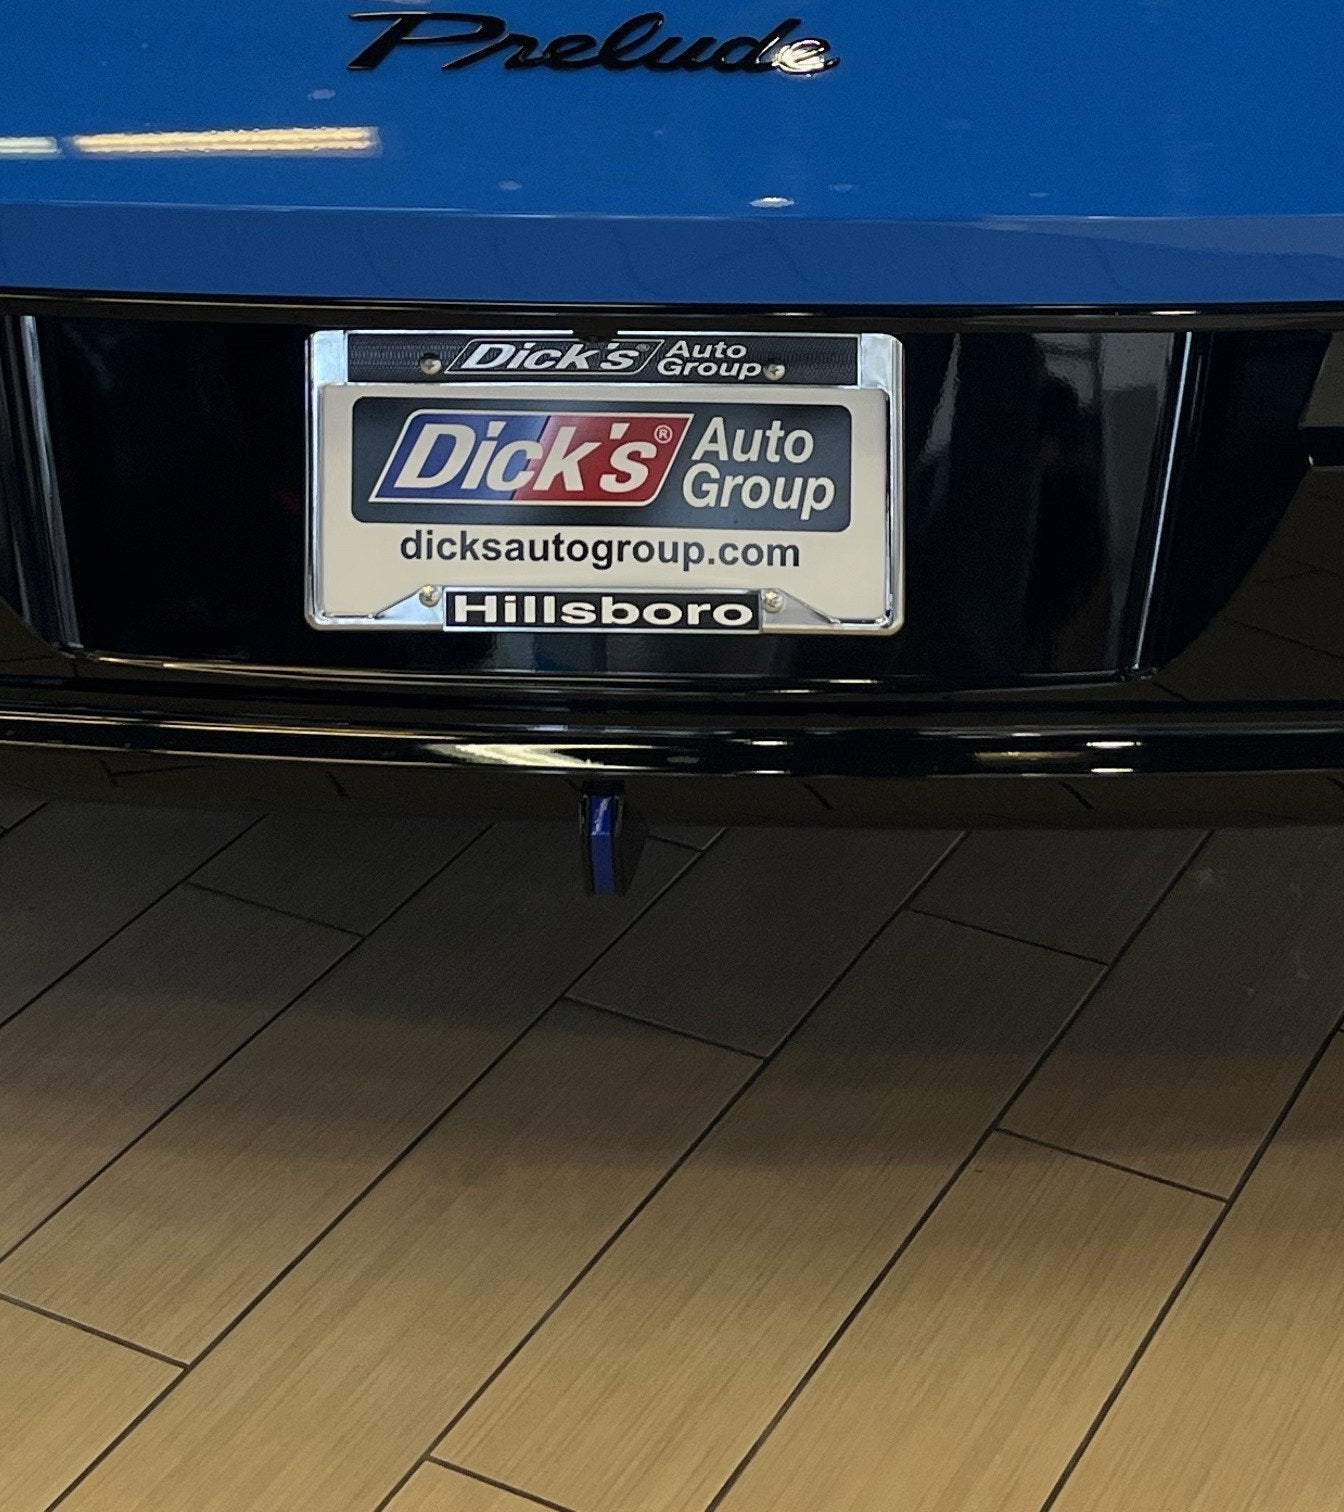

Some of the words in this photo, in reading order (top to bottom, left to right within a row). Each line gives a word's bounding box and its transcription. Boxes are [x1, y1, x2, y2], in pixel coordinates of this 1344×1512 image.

[346, 10, 841, 77] Prelude
[460, 342, 640, 370] Dick's
[665, 340, 747, 359] Auto
[657, 357, 762, 381] Group
[692, 416, 813, 463] Auto
[683, 462, 835, 520] Group
[400, 529, 800, 571] dicksautogroup.com
[453, 594, 754, 626] Hillsboro
